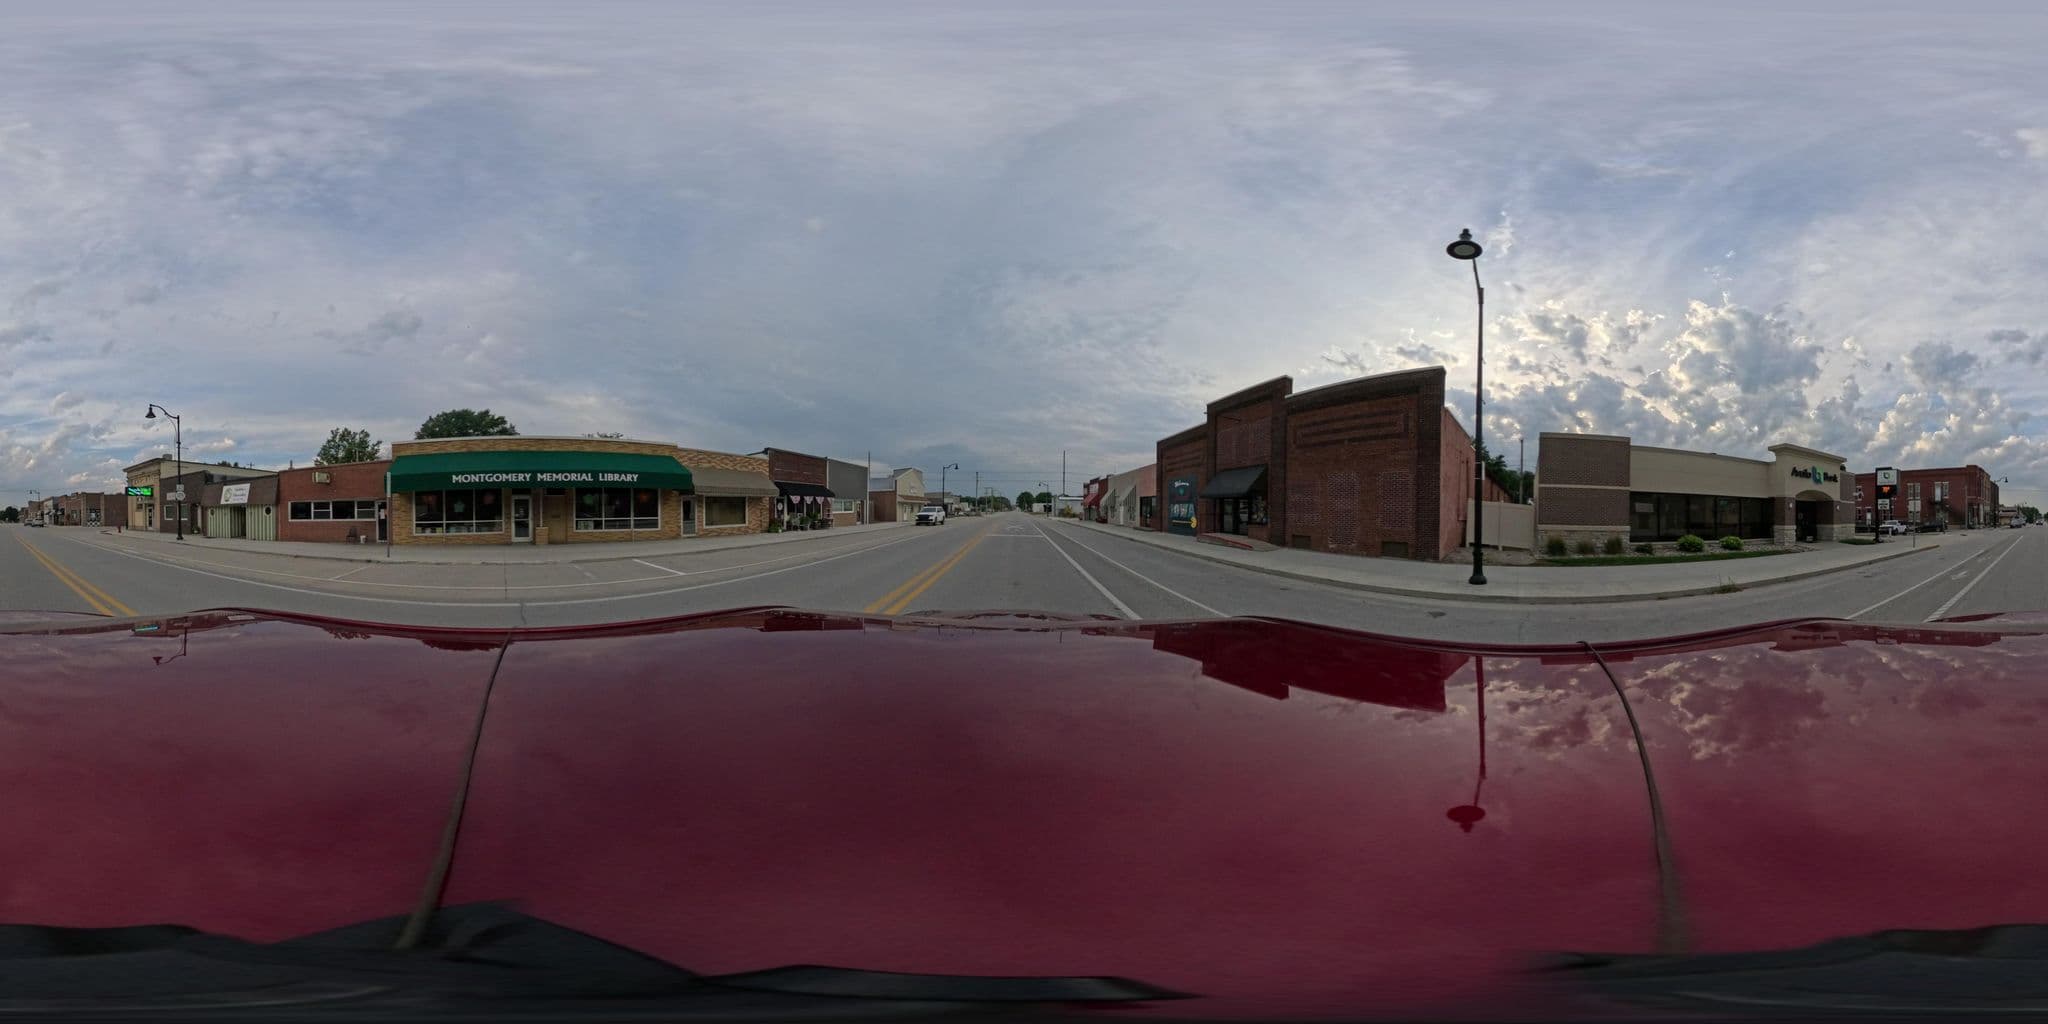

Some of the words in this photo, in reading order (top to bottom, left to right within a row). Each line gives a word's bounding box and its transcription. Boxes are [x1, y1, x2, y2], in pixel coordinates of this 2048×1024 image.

[452, 473, 531, 483] MONTGOMERY
[537, 473, 593, 481] MEMORIAL
[599, 473, 639, 482] LIBRARY
[1170, 503, 1195, 518] IOWA
